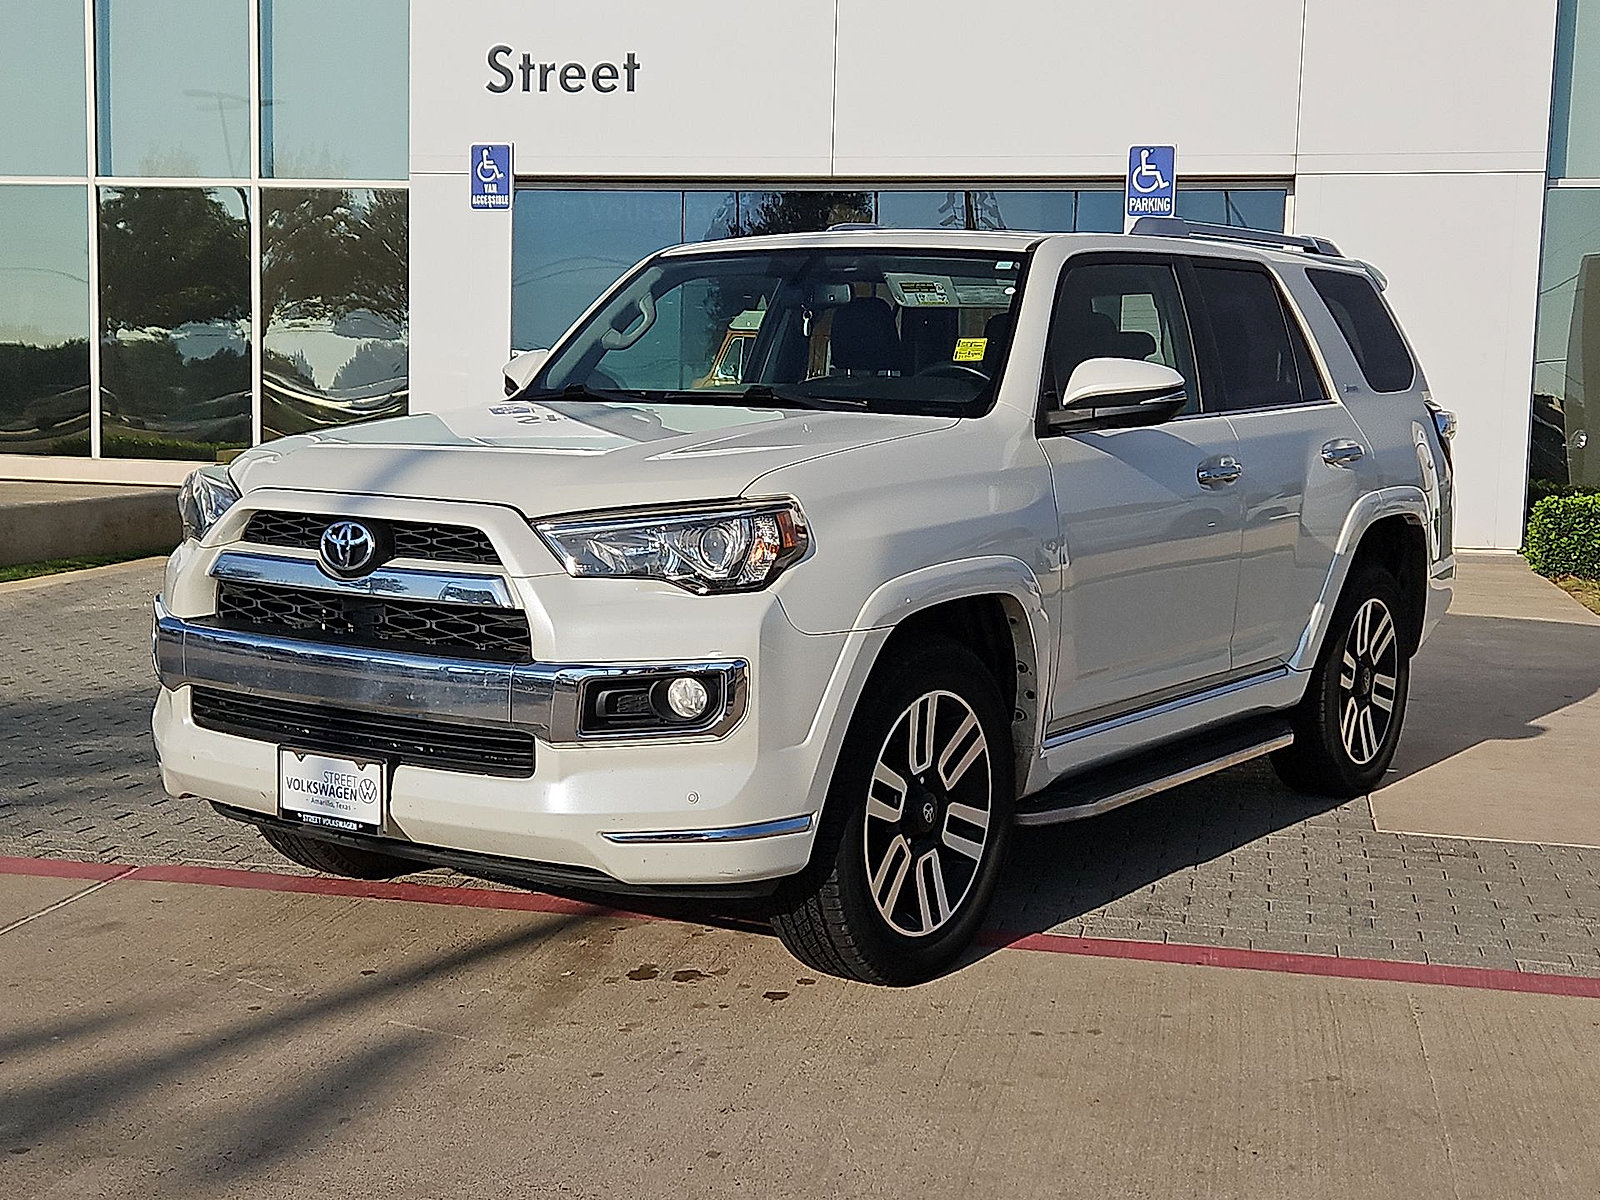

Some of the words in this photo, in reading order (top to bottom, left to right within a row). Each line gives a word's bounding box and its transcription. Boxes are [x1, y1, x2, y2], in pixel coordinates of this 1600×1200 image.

[486, 45, 641, 93] Street
[1129, 197, 1171, 212] PARKING
[323, 770, 358, 788] STREET
[286, 776, 358, 801] VOLKSWAGEN
[336, 801, 351, 811] Texas
[302, 814, 322, 824] STREET
[322, 817, 358, 831] VOLKSWAGEN
